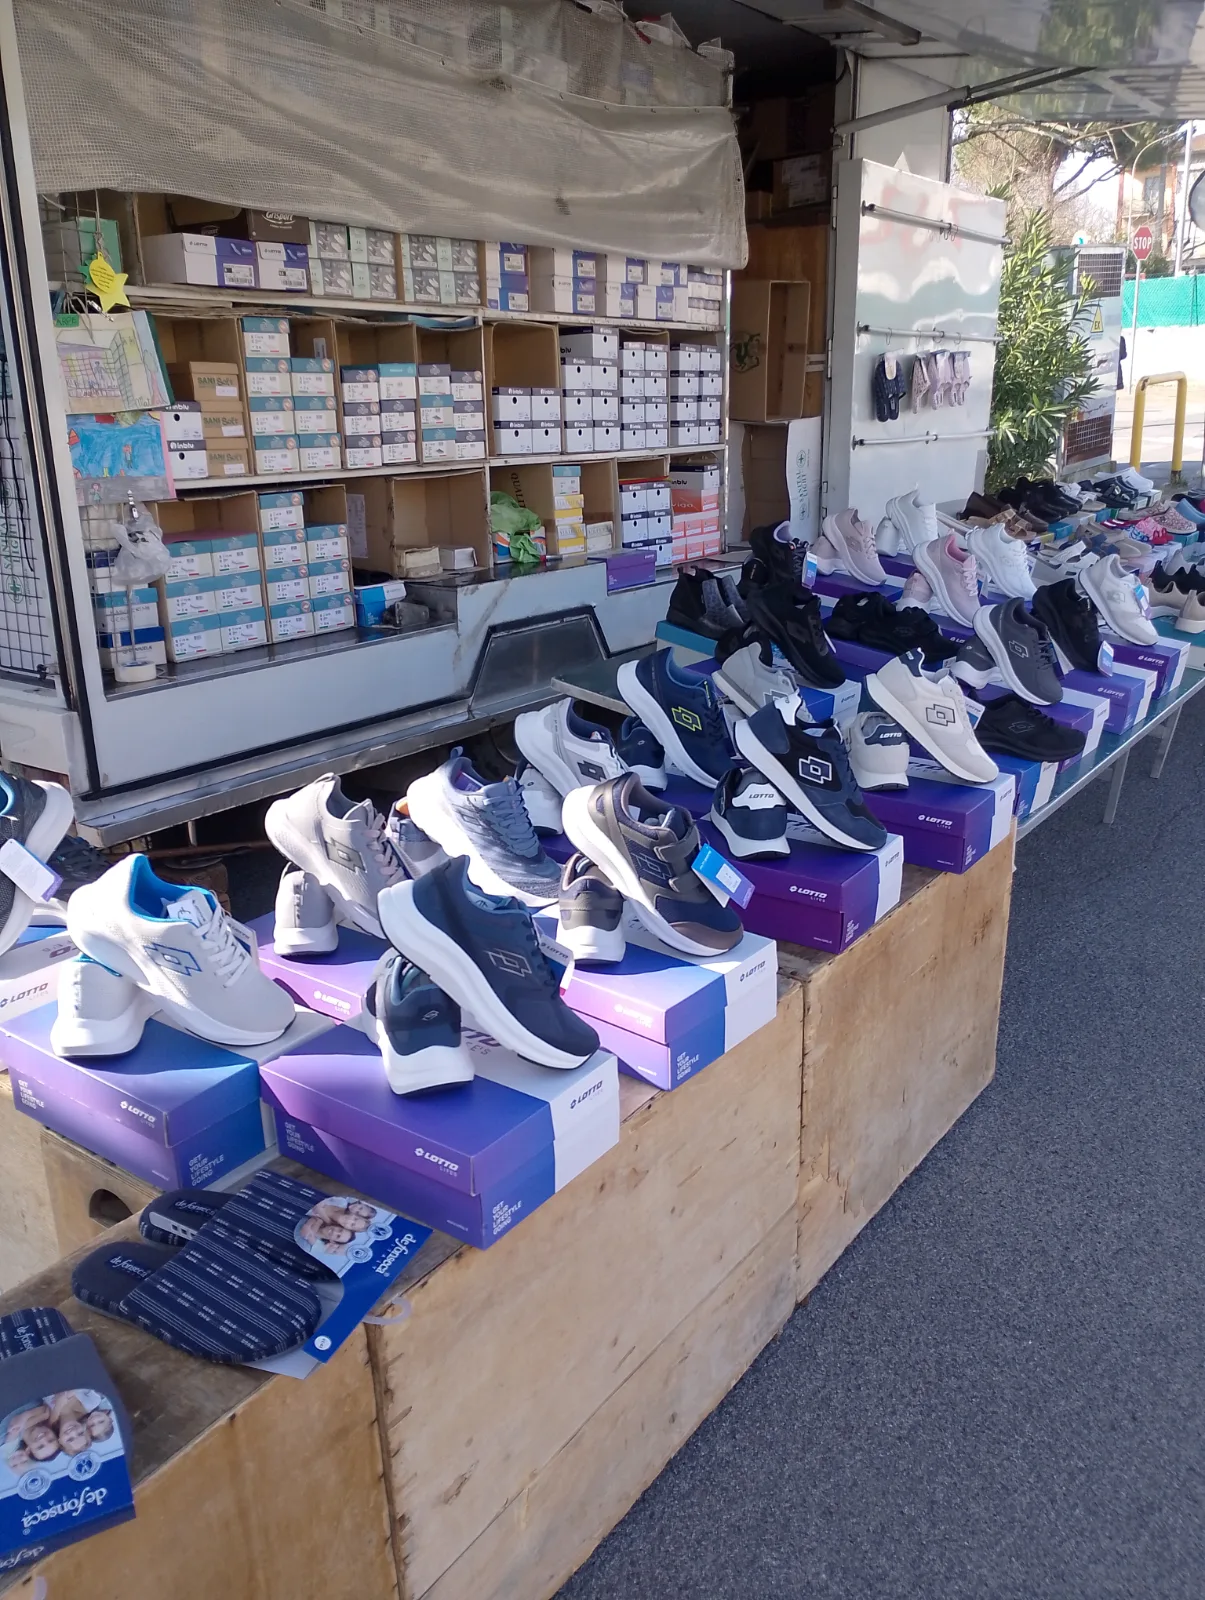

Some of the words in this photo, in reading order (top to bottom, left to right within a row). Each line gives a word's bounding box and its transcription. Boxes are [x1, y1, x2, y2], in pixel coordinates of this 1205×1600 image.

[1134, 237, 1152, 250] STOP
[1094, 320, 1100, 330] EX
[510, 472, 527, 508] QUALIT
[1103, 688, 1125, 697] LOTTO
[925, 816, 953, 826] LOTTO
[797, 887, 828, 899] LOTTO
[745, 960, 766, 978] LOTTO
[10, 982, 49, 1003] LOTTO
[461, 1026, 501, 1047] TTO
[577, 1080, 604, 1104] LOTTO
[127, 1106, 157, 1123] LOTTO
[284, 1121, 297, 1130] GET
[286, 1128, 301, 1139] YOUR
[286, 1135, 315, 1153] LIFESTYLE
[287, 1142, 305, 1154] GOING
[188, 1153, 203, 1167] GET
[189, 1157, 209, 1172] YOUR
[190, 1154, 225, 1180] LIFESTYLE
[424, 1152, 459, 1171] LOTTO
[191, 1169, 214, 1187] GOING
[492, 1200, 504, 1214] GET
[492, 1204, 509, 1220] YOUR
[492, 1200, 522, 1229] LIFESTYLE
[492, 1216, 512, 1235] GOING
